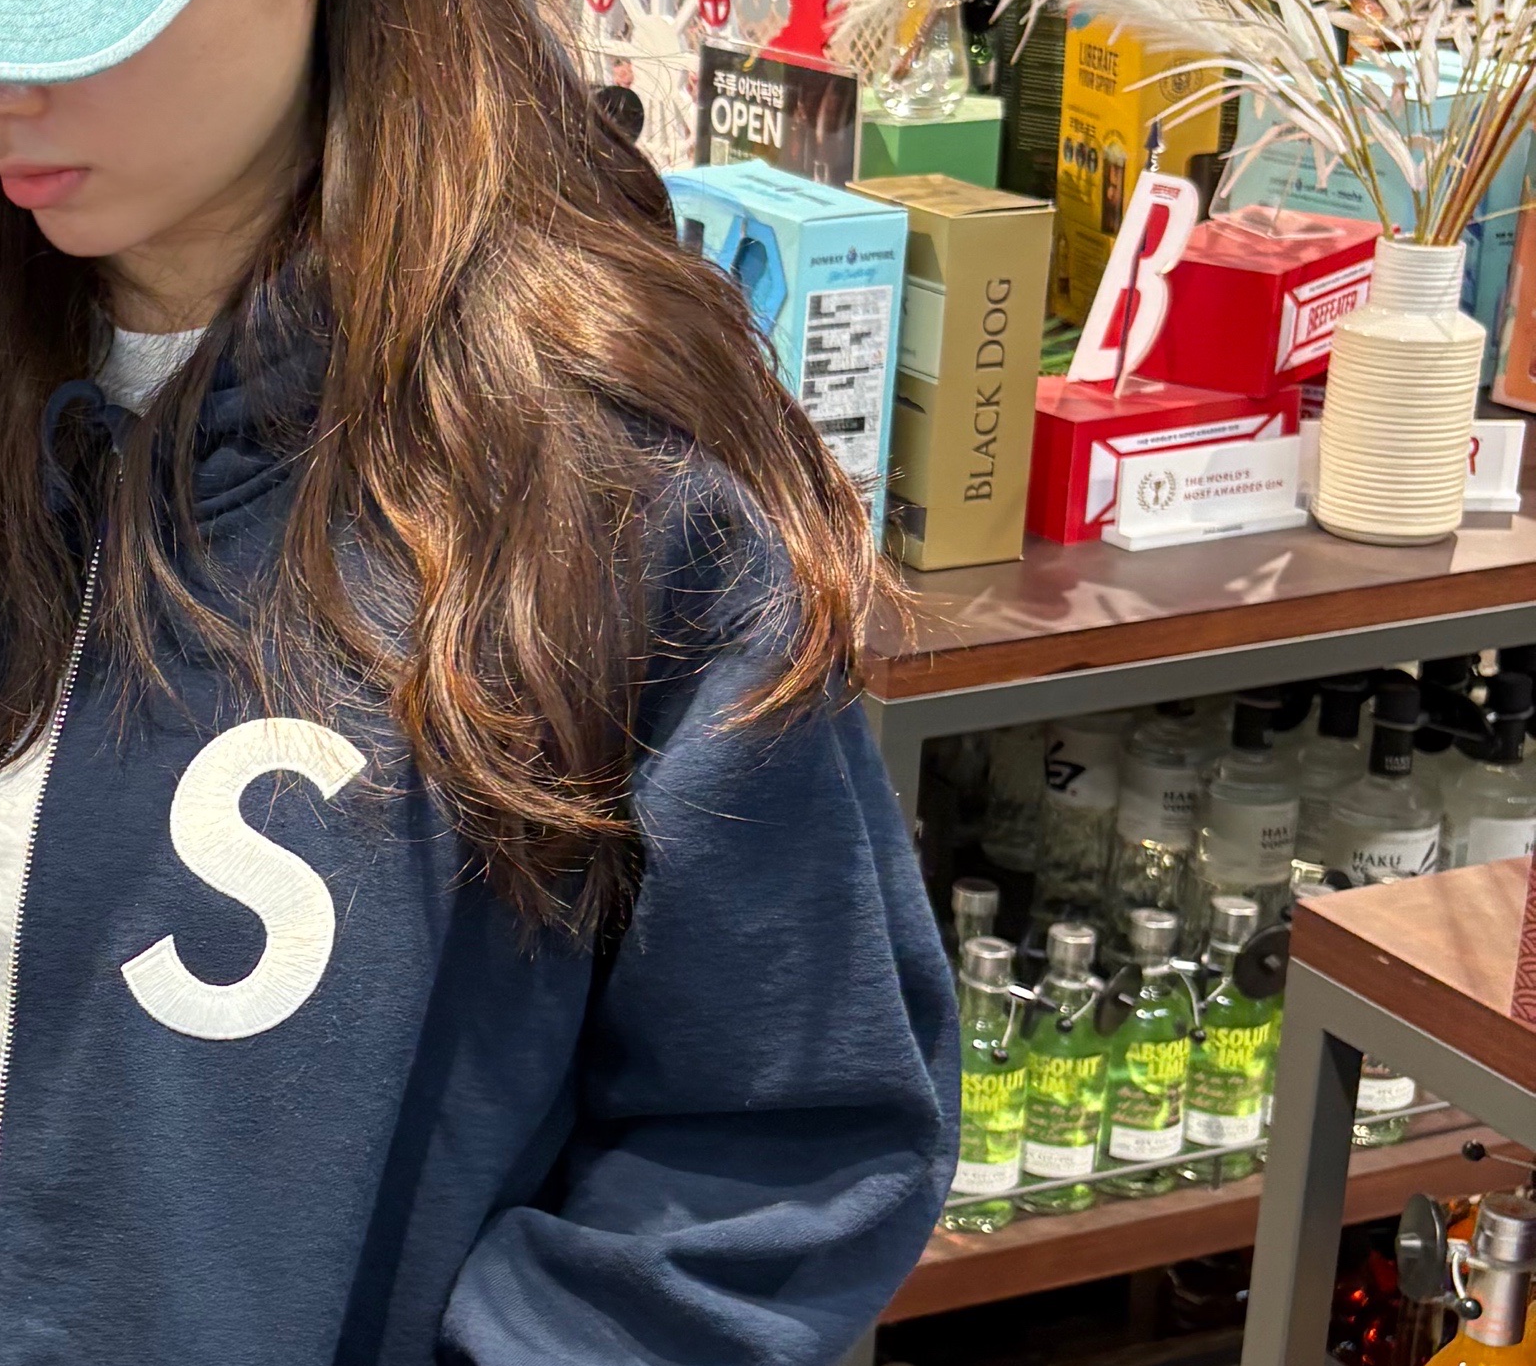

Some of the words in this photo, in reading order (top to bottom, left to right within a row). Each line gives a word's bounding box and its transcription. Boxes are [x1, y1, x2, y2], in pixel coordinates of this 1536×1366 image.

[713, 72, 738, 97] 주류
[711, 97, 783, 149] OPEN
[976, 278, 1013, 372] DOG
[964, 383, 1003, 503] BLACK
[1185, 477, 1204, 487] THE
[1205, 468, 1251, 483] WORLD'S
[1184, 489, 1212, 501] MOST
[1214, 483, 1263, 497] AWARDED
[1353, 850, 1401, 869] HAKU
[120, 717, 367, 1040] S
[1126, 1038, 1190, 1063] ABSOLU
